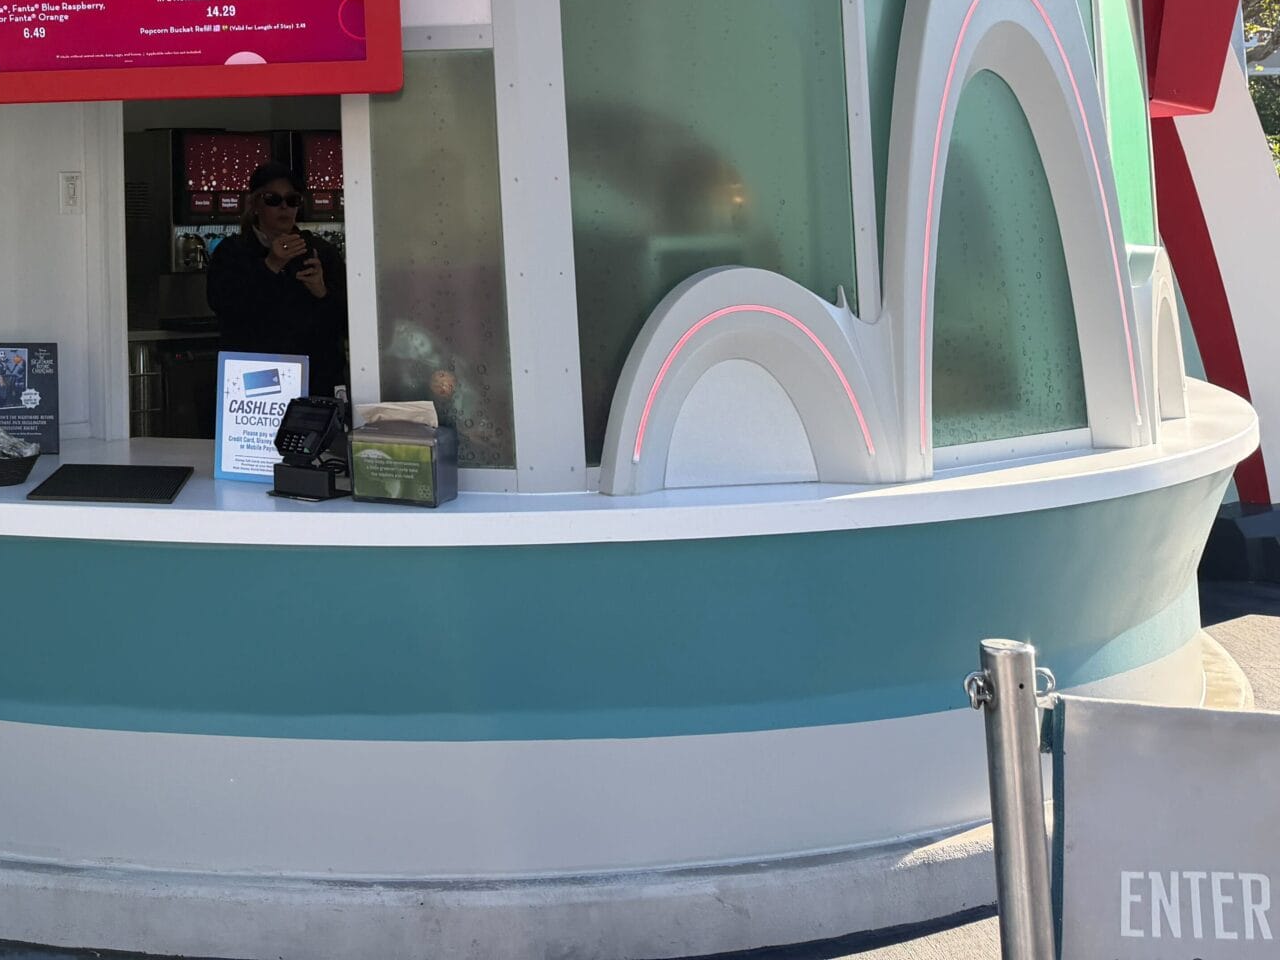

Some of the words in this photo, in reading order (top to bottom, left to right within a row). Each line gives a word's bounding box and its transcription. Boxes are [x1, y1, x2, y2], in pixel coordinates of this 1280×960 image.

[41, 2, 60, 11] Blue
[61, 1, 105, 11] Raspberry,
[206, 5, 236, 17] 14.29
[38, 13, 69, 22] Orange
[23, 27, 46, 38] 6.49
[140, 27, 168, 35] Popcorn
[229, 400, 286, 416] CASHLES
[236, 416, 280, 427] LOCATIO
[1120, 871, 1273, 940] ENTER
